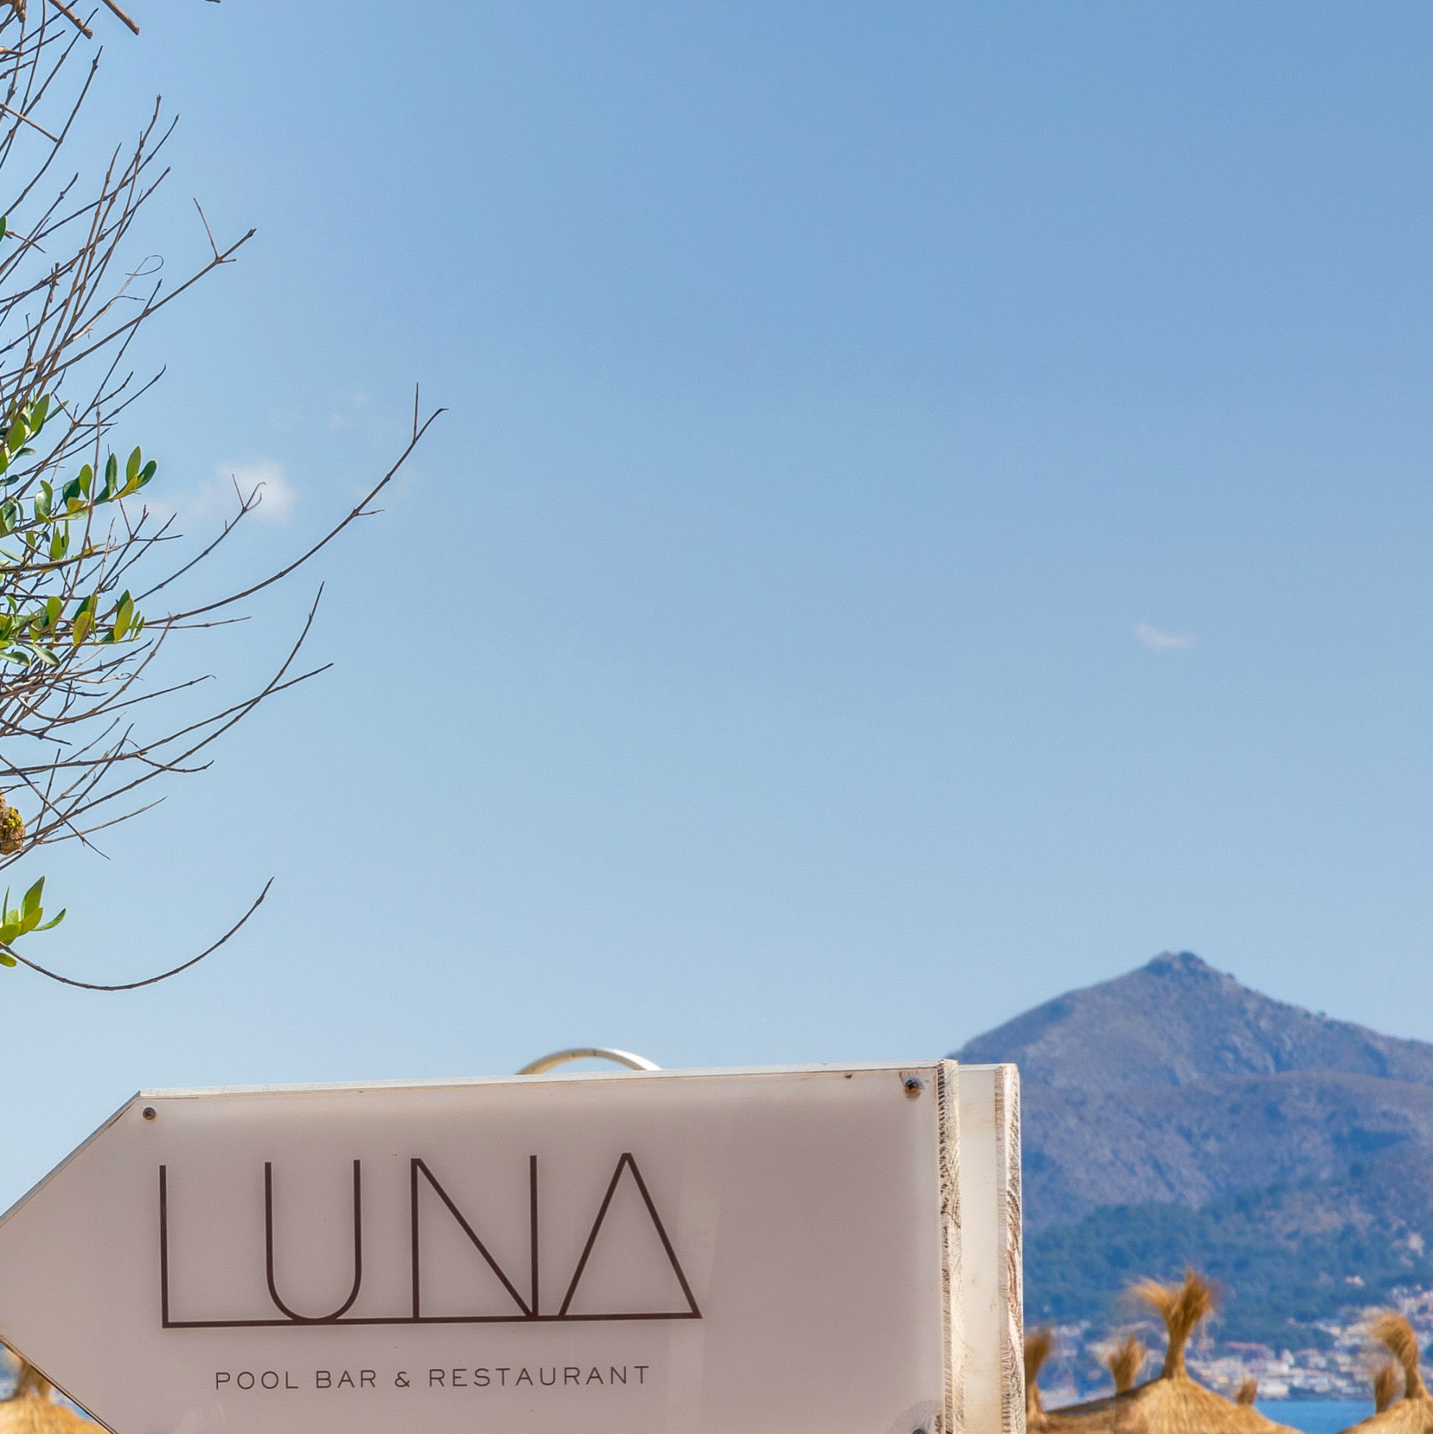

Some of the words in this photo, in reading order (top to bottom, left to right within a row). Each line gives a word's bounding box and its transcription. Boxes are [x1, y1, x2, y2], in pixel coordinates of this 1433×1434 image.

[158, 1151, 702, 1329] LUNA
[215, 1371, 299, 1390] POOL
[315, 1369, 377, 1389] BAR
[394, 1371, 411, 1388] &
[428, 1366, 650, 1388] RESTAURANT
